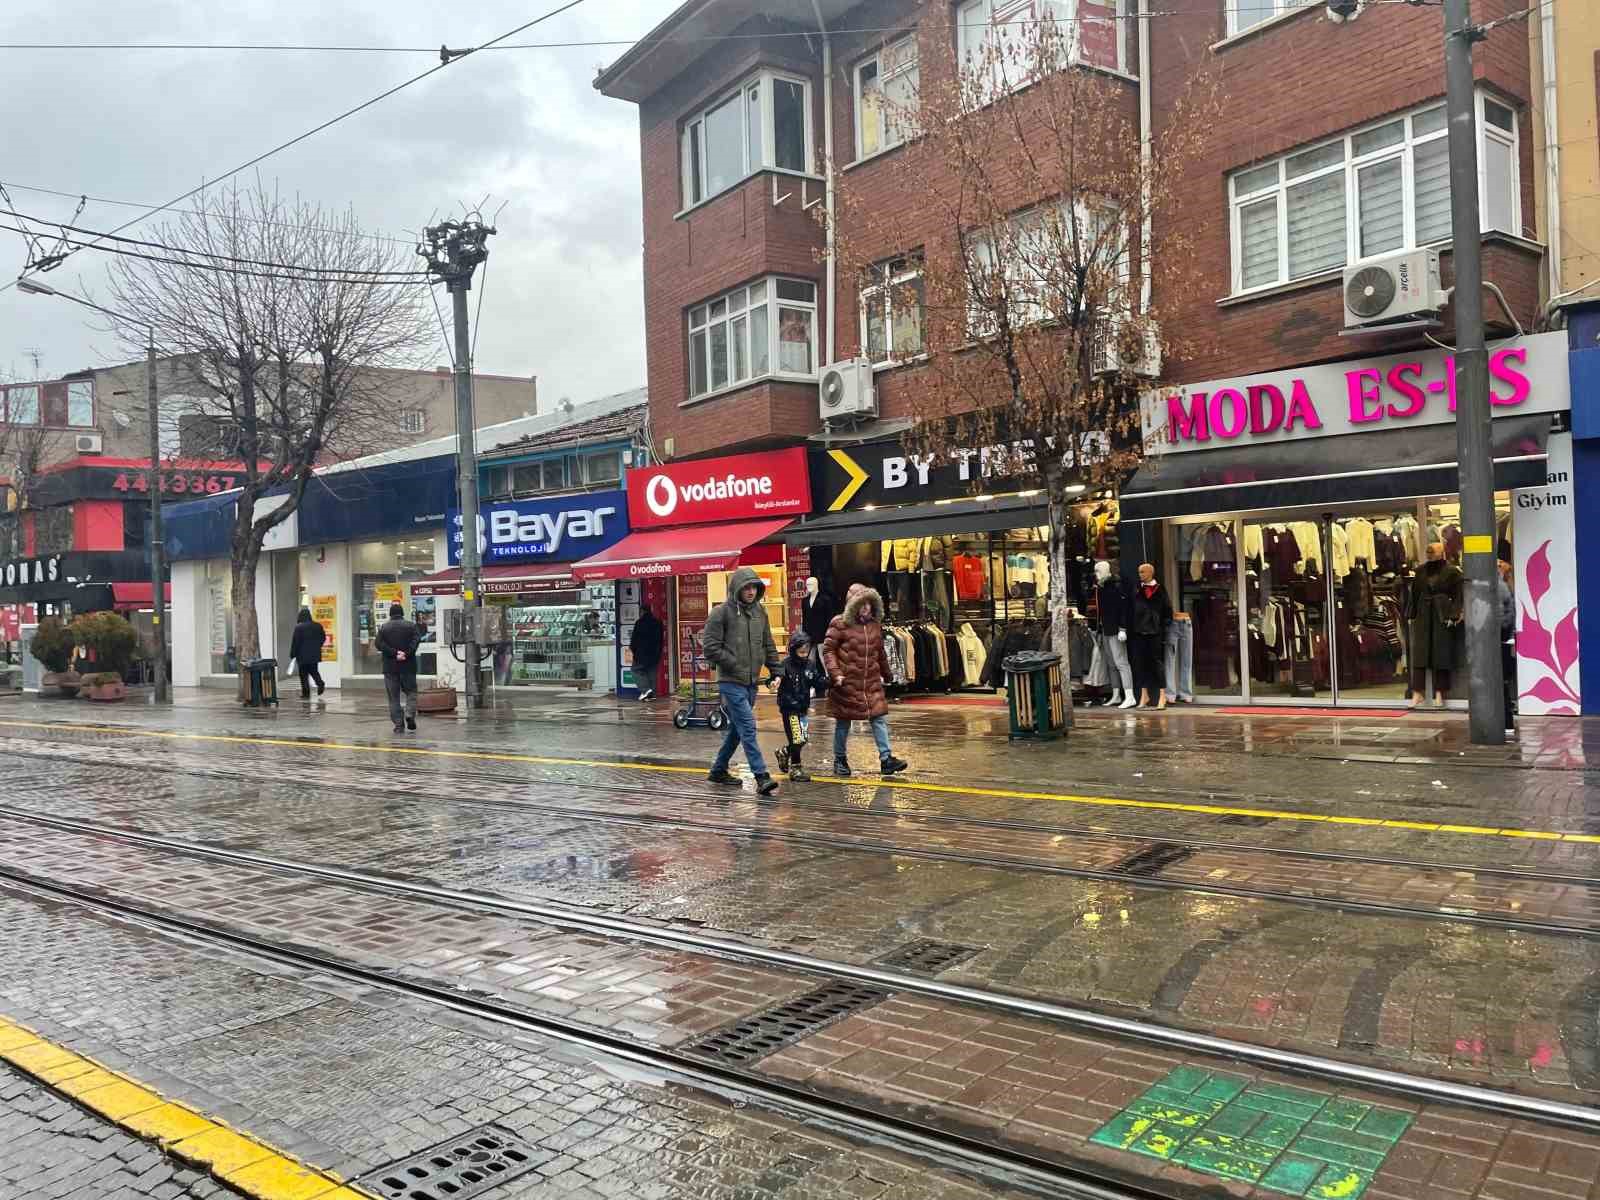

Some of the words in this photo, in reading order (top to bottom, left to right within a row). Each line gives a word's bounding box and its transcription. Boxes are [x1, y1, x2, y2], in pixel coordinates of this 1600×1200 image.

[1167, 379, 1323, 444] MODA
[1344, 347, 1532, 424] ES-S
[883, 453, 935, 489] BY
[680, 474, 772, 502] vodafone
[1518, 492, 1567, 510] Giyim
[491, 507, 616, 553] Bayar
[637, 562, 672, 575] vodafone
